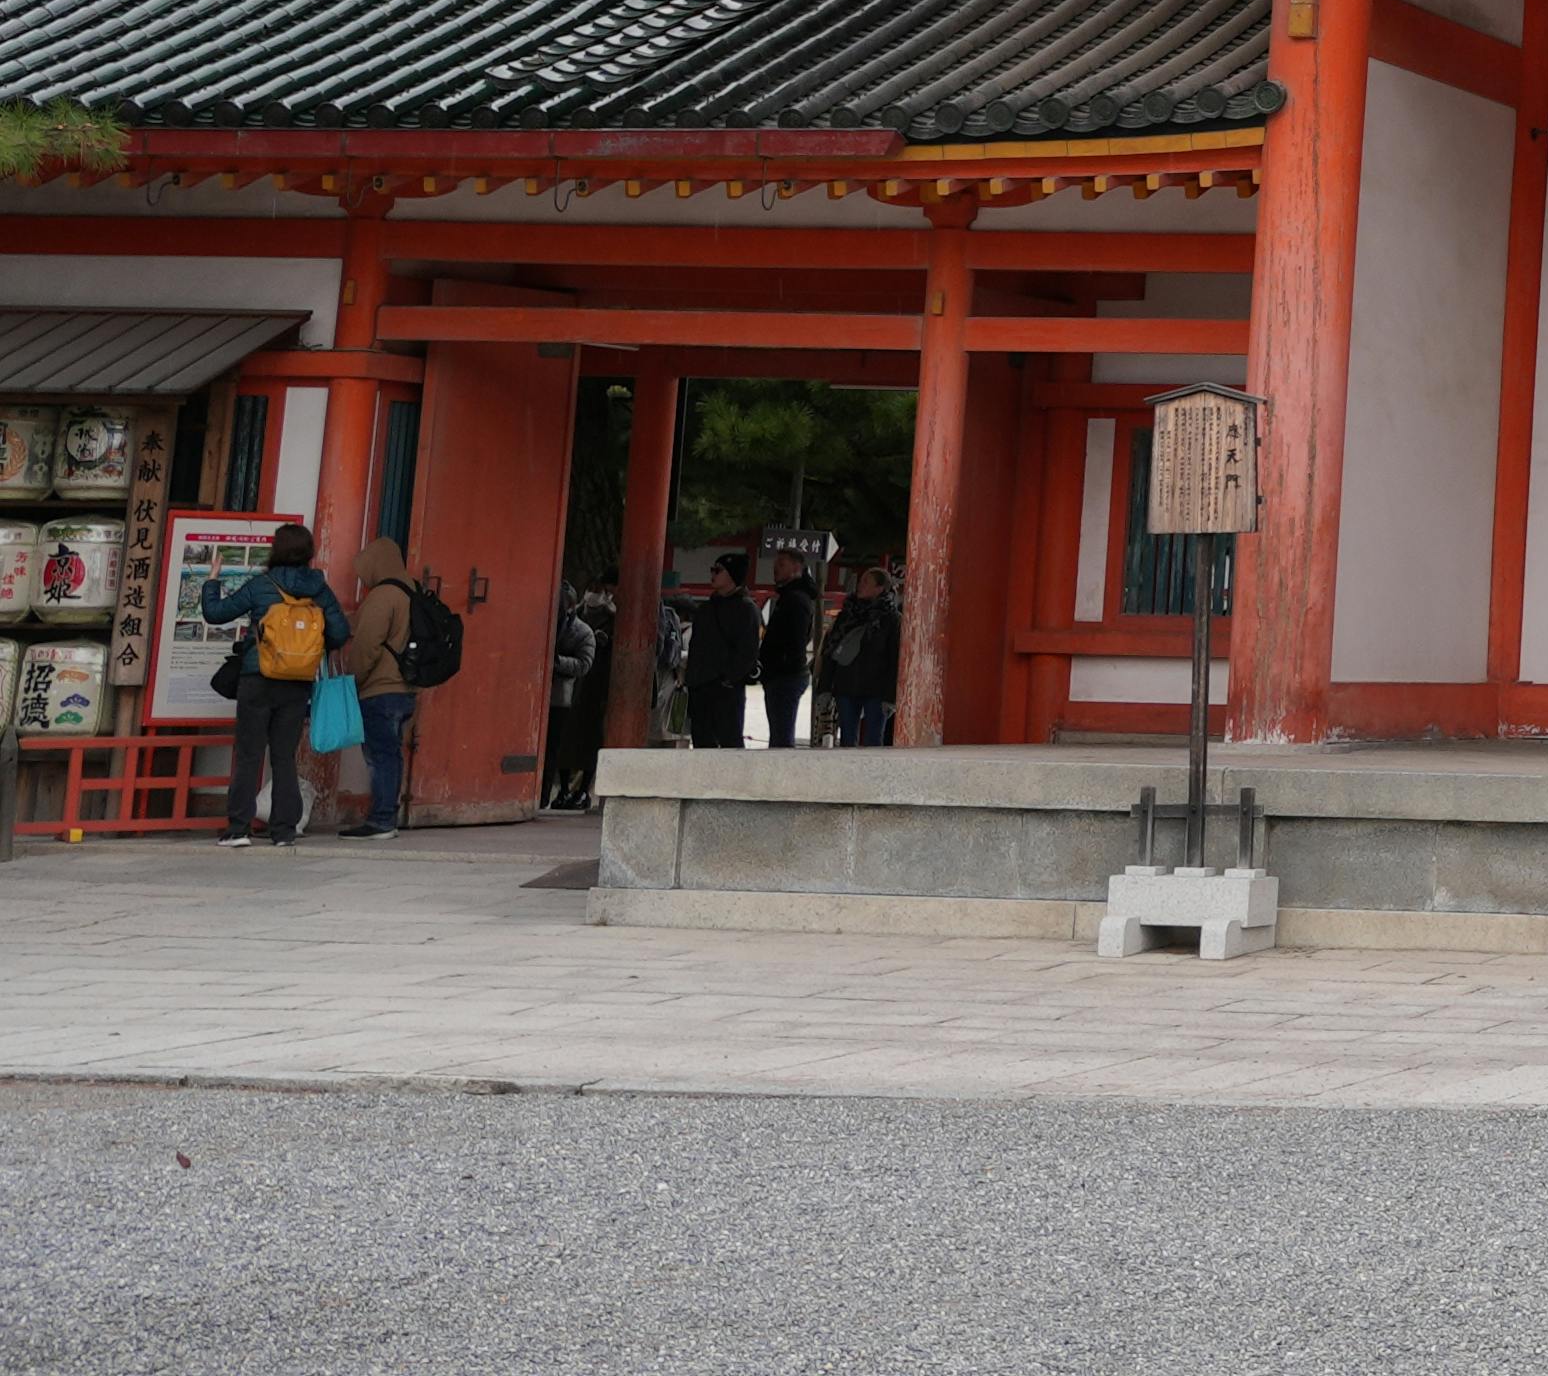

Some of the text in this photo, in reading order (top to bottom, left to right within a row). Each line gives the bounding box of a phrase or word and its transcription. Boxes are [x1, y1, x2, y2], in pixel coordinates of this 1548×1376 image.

[44, 542, 82, 604] 京姫
[116, 430, 165, 666] 奉献 伏見酒造組合
